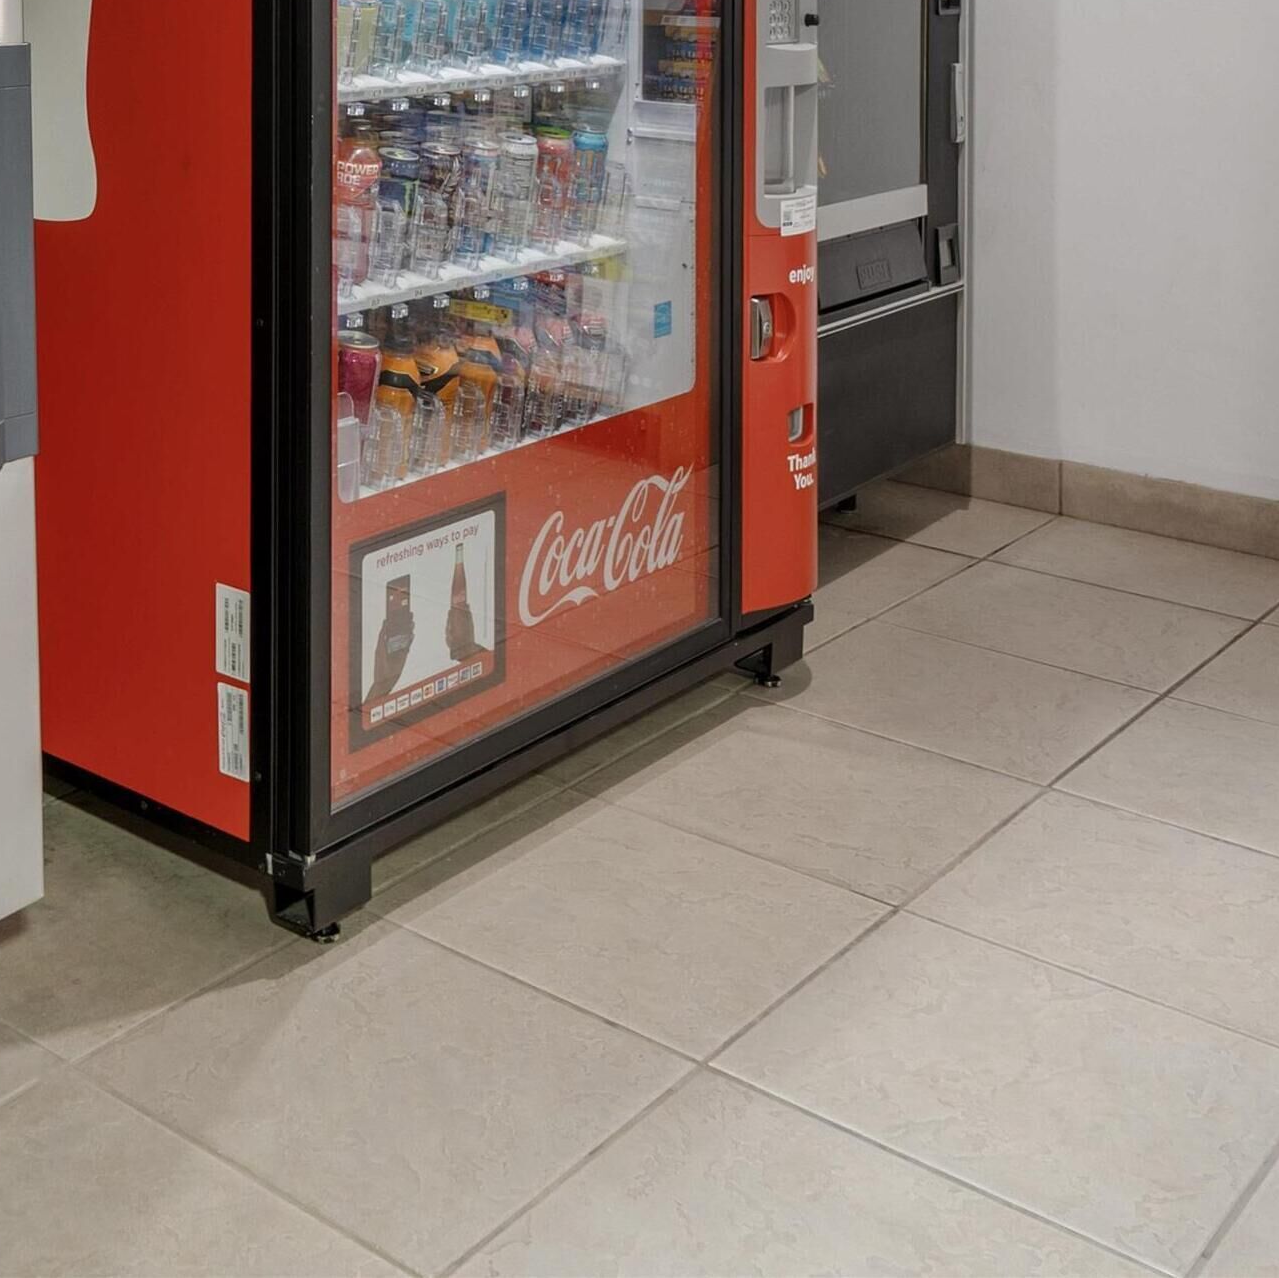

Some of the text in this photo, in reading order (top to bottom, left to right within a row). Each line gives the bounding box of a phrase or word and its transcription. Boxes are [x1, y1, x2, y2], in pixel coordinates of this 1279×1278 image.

[788, 265, 815, 283] enjoy
[376, 522, 480, 570] refreshing ways to pay
[518, 463, 695, 628] Coca-Cola
